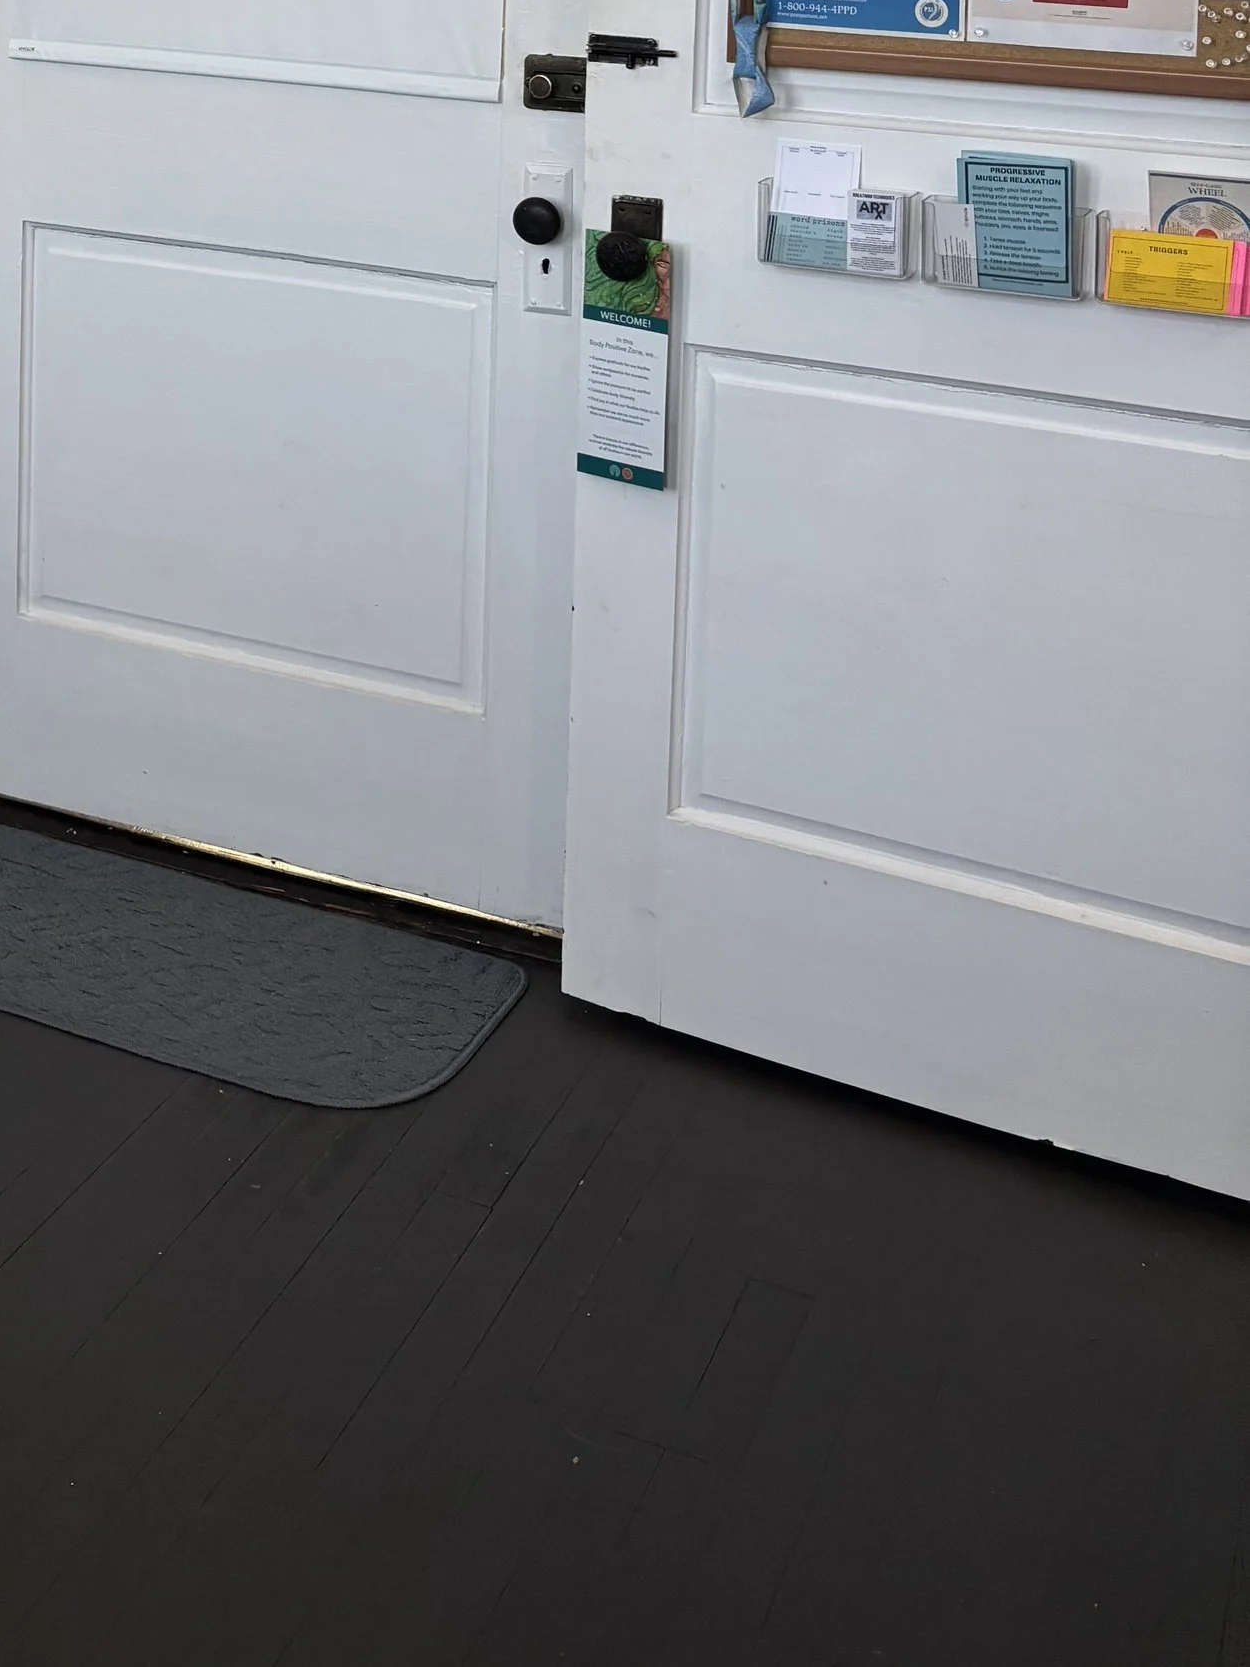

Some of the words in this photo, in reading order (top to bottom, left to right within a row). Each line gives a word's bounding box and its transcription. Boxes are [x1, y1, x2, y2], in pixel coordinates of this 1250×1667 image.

[778, 2, 857, 14] 1-800-944-4PPD
[990, 167, 1045, 176] PROGRESSIVE
[1010, 176, 1061, 186] RELAXATION
[1188, 187, 1227, 197] WHEEL
[859, 201, 889, 214] ART
[812, 217, 846, 227] prisons
[1149, 246, 1188, 255] TRIGGERS
[600, 310, 651, 328] WELCOME!
[589, 339, 603, 348] Body
[605, 342, 627, 353] Positive
[628, 347, 644, 356] Zone,
